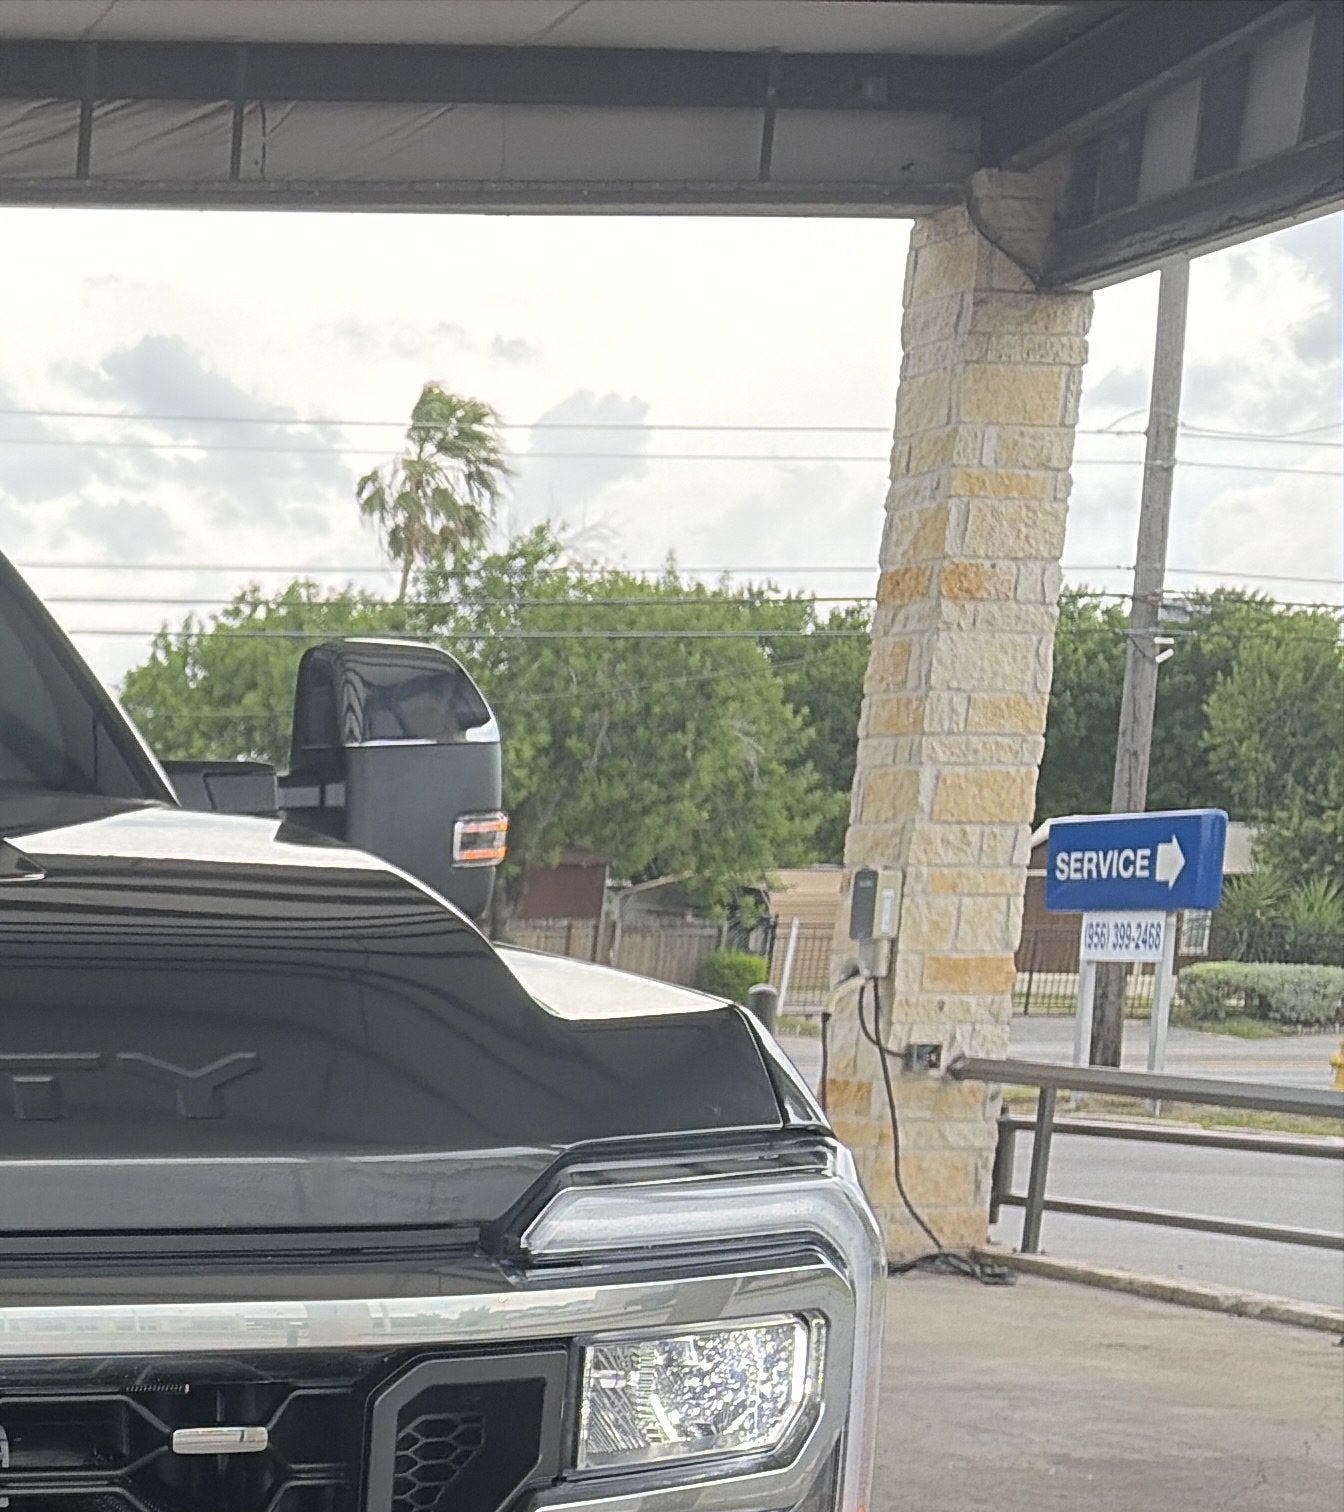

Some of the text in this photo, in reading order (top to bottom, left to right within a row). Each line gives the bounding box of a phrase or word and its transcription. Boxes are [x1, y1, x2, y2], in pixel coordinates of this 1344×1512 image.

[1055, 848, 1151, 880] SERVICE
[1084, 921, 1161, 950] (956) 399-2468
